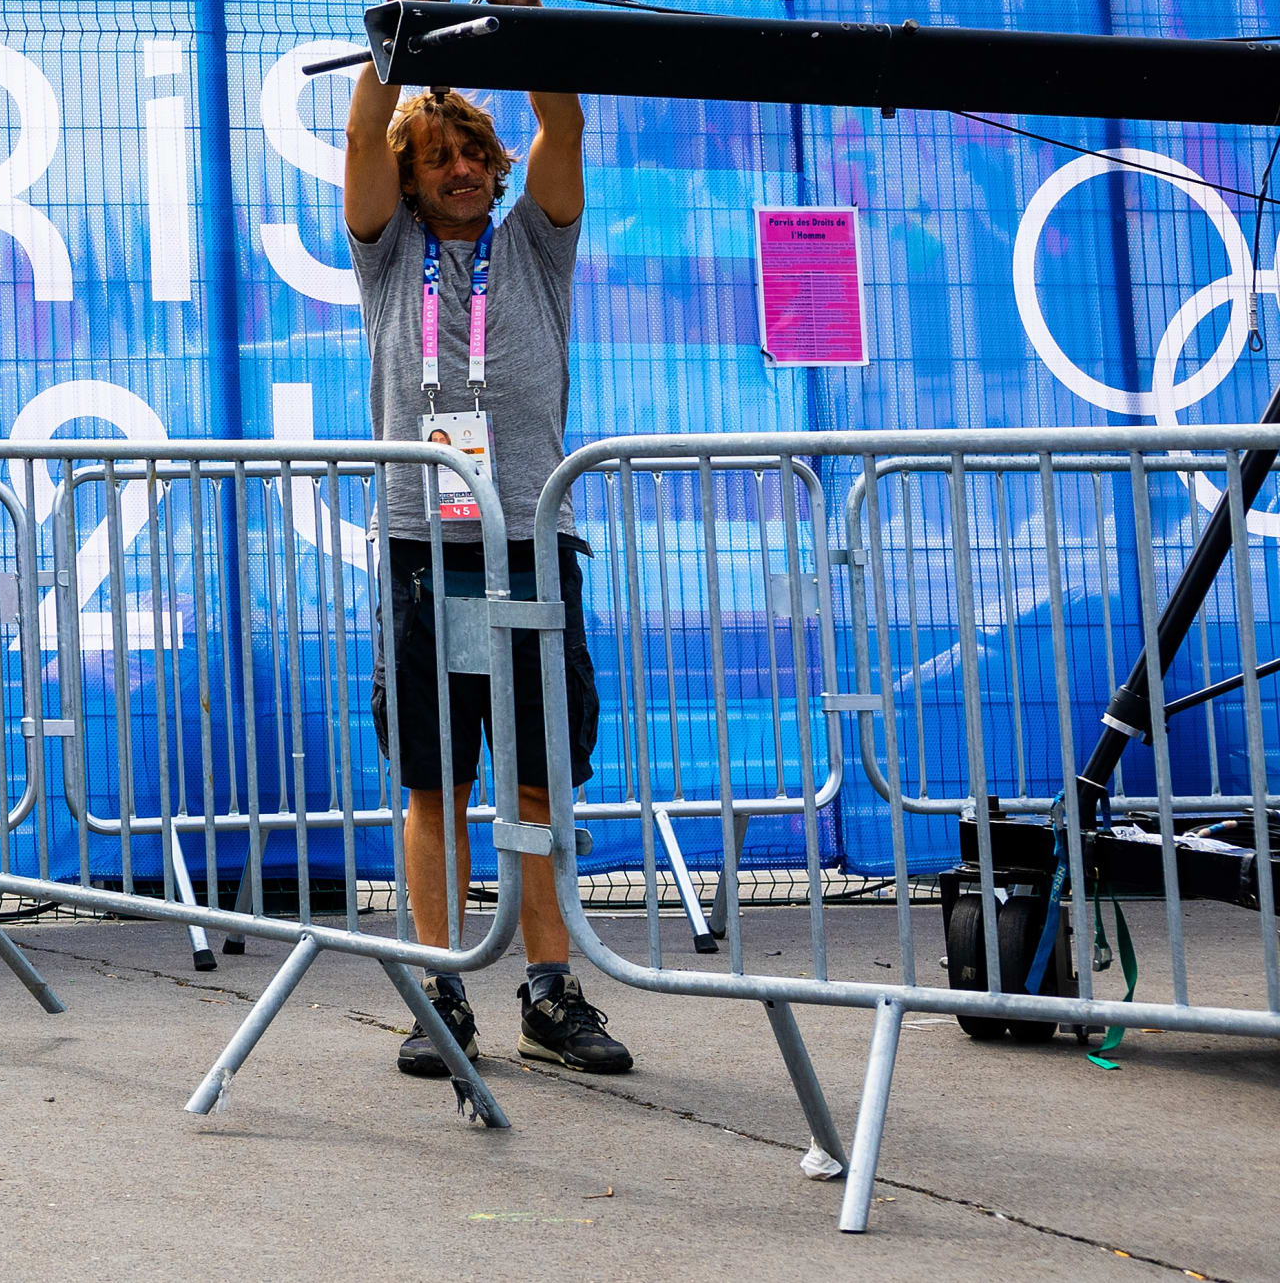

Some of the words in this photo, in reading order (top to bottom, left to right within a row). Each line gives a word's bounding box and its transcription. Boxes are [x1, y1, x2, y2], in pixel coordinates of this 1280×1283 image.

[769, 218, 793, 227] Parvis
[796, 218, 810, 226] des
[812, 218, 834, 227] Droits
[836, 218, 845, 226] de
[791, 231, 826, 239] l'Homme
